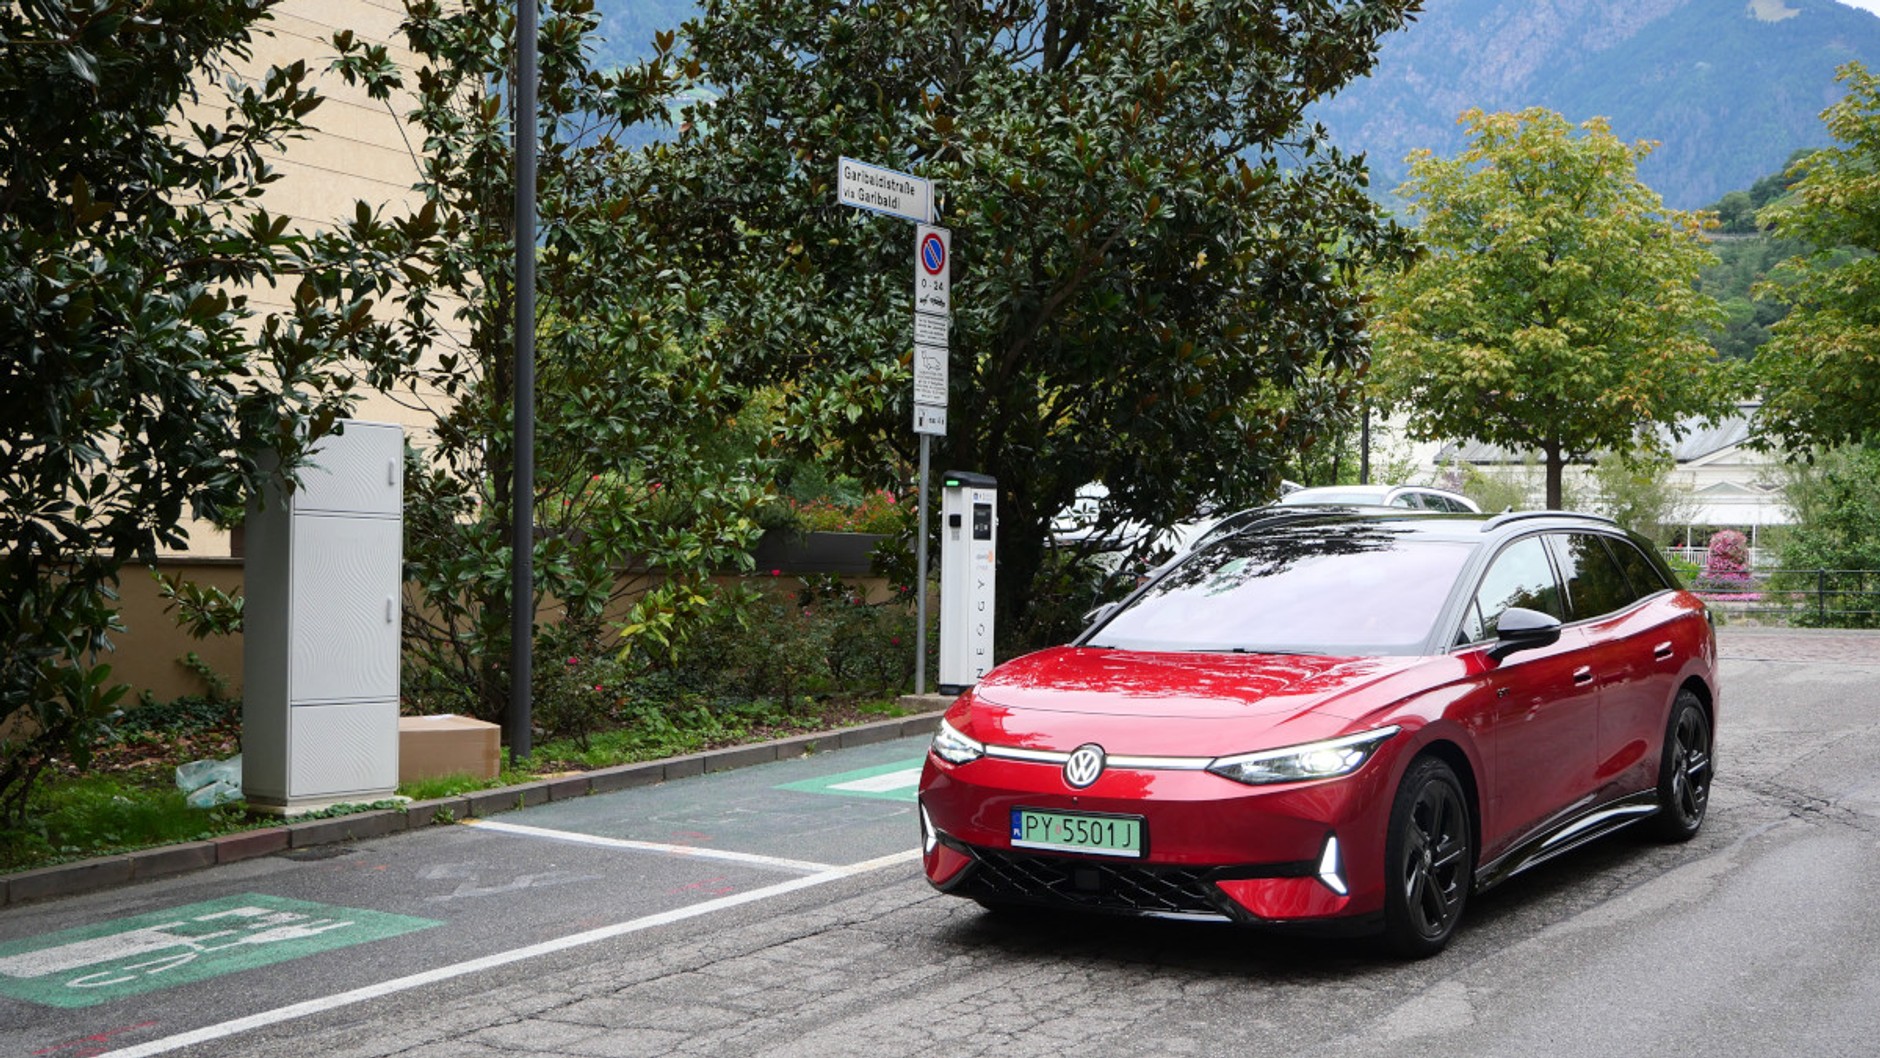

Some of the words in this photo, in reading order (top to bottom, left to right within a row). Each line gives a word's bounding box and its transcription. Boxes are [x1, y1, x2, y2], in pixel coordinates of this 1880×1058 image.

[844, 165, 915, 196] Garibaldistraße
[843, 187, 855, 199] via
[858, 188, 900, 210] Garibaldi
[921, 278, 927, 288] 0
[934, 281, 944, 291] 24
[976, 579, 985, 679] NEOGY
[1025, 815, 1053, 841] PY
[1063, 818, 1131, 848] 5501J
